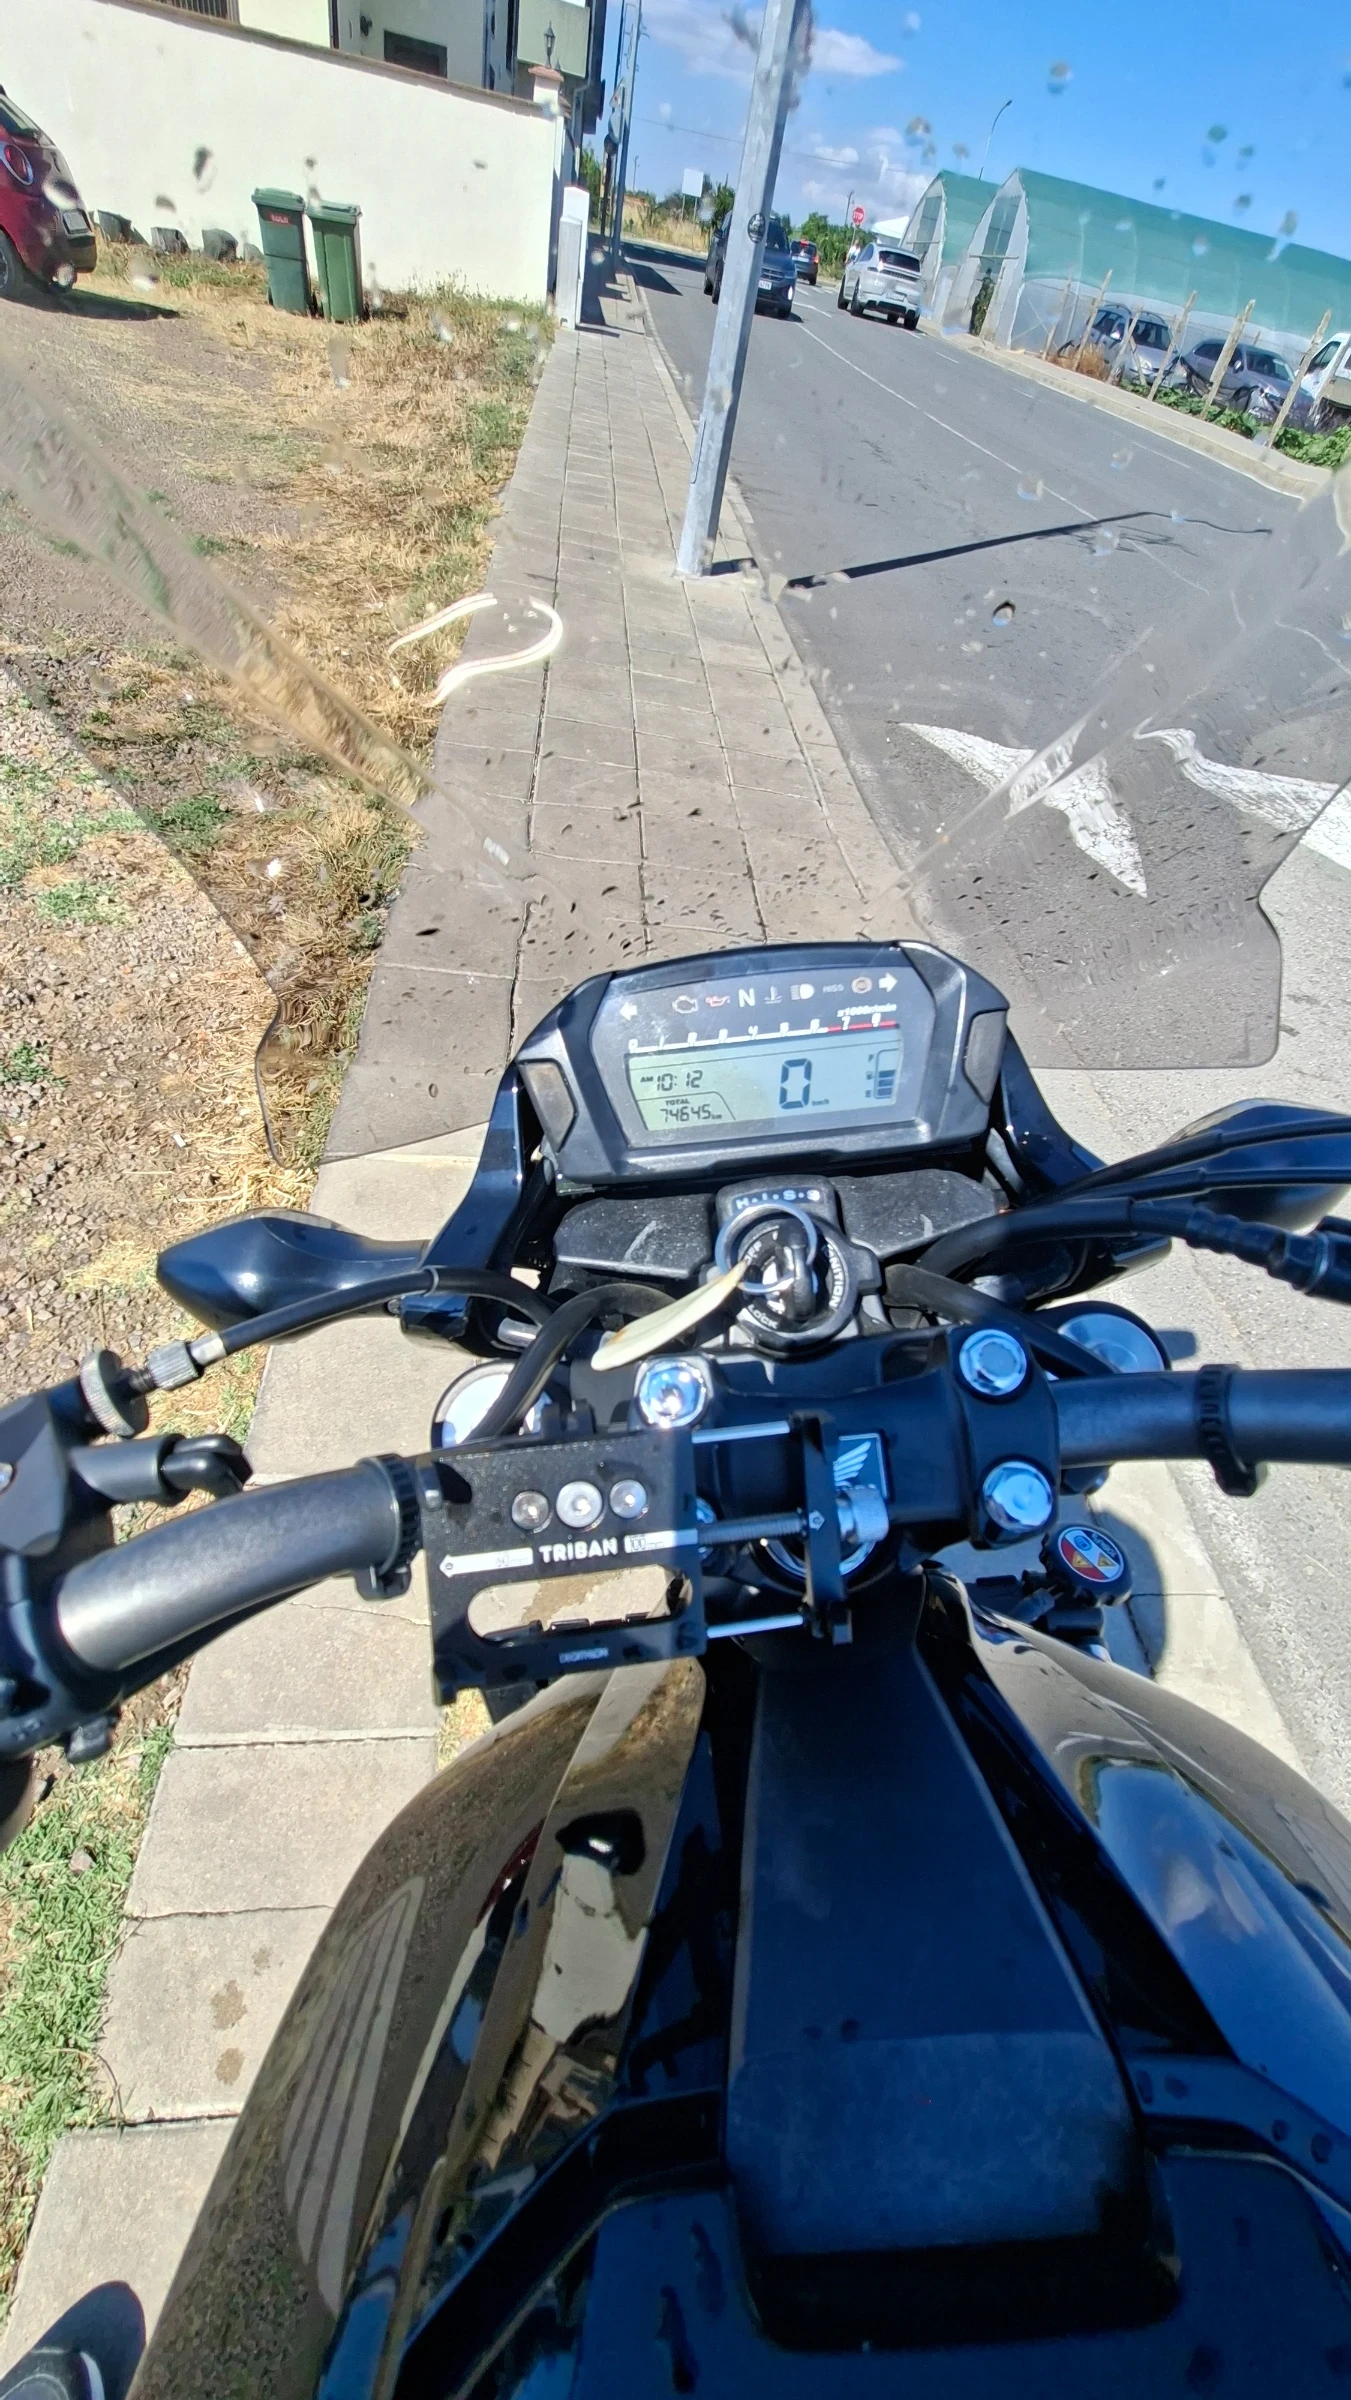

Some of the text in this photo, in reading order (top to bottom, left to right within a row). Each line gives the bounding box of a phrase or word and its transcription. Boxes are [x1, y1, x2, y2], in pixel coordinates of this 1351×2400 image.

[738, 988, 756, 1007] N
[779, 1058, 812, 1109] 0
[660, 1104, 711, 1122] 74645
[665, 1098, 690, 1106] TOTAL
[747, 1304, 779, 1330] LOCK
[538, 1537, 618, 1563] TRIBAN
